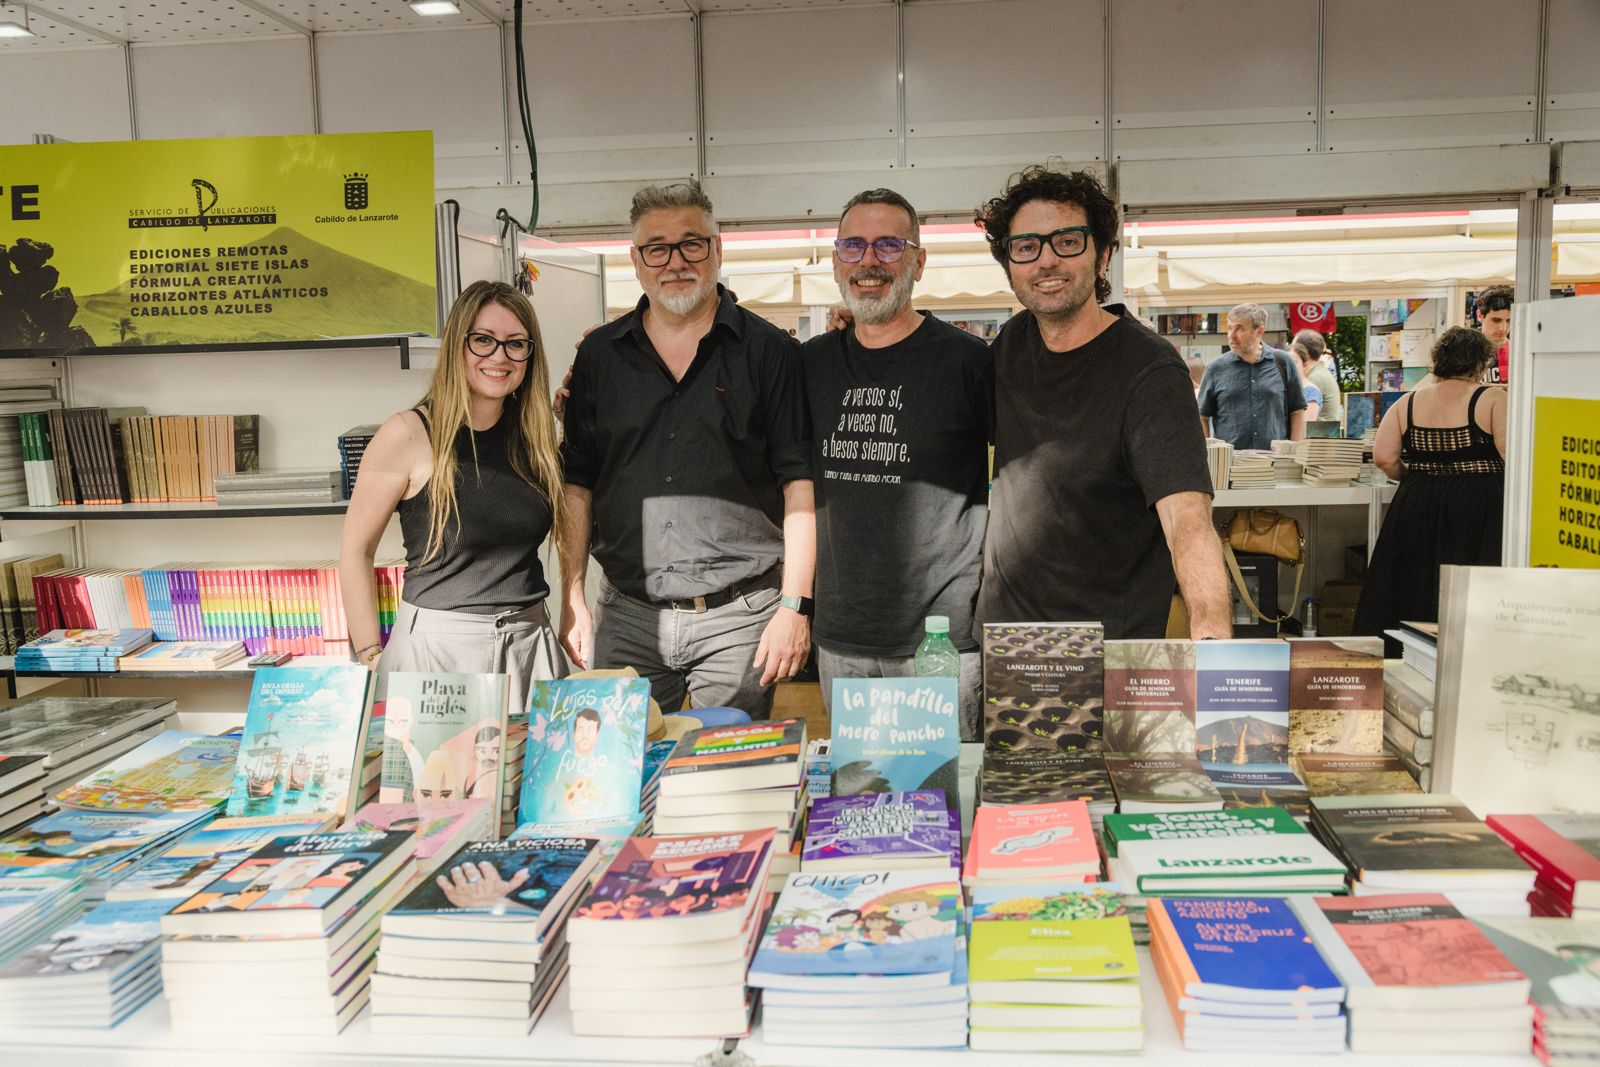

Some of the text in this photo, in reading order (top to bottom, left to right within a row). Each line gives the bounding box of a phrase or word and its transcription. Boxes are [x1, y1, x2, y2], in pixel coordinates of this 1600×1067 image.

[0, 184, 41, 221] E
[129, 208, 173, 217] SERVICIO
[178, 207, 189, 215] DE
[314, 213, 399, 223] Cabildo de Lanzarote
[132, 215, 273, 227] CABILDO DE LANZAROTE
[130, 245, 288, 260] EDICIONES REMOTAS
[130, 258, 309, 274] EDITORIAL SIETE ISLAS
[130, 274, 282, 288] FÓRMULA CREATIVA
[130, 287, 329, 303] HORIZONTES ATLÁNTICOS
[130, 303, 273, 317] CABALLOS AZULES
[842, 385, 902, 410] a versos sí,
[838, 413, 897, 436] a veces no,
[822, 432, 910, 466] a besos siempre.
[1496, 612, 1566, 626] de Canarias
[420, 696, 466, 718] Inglés
[870, 707, 898, 726] del
[713, 726, 773, 738] VAGOS
[838, 724, 879, 741] mero
[695, 742, 777, 755] MALEANTES
[868, 804, 913, 816] CINCO
[1128, 818, 1256, 832] volcanes
[469, 838, 587, 850] ANA VICIOSA
[1158, 856, 1312, 868] Lanzarote
